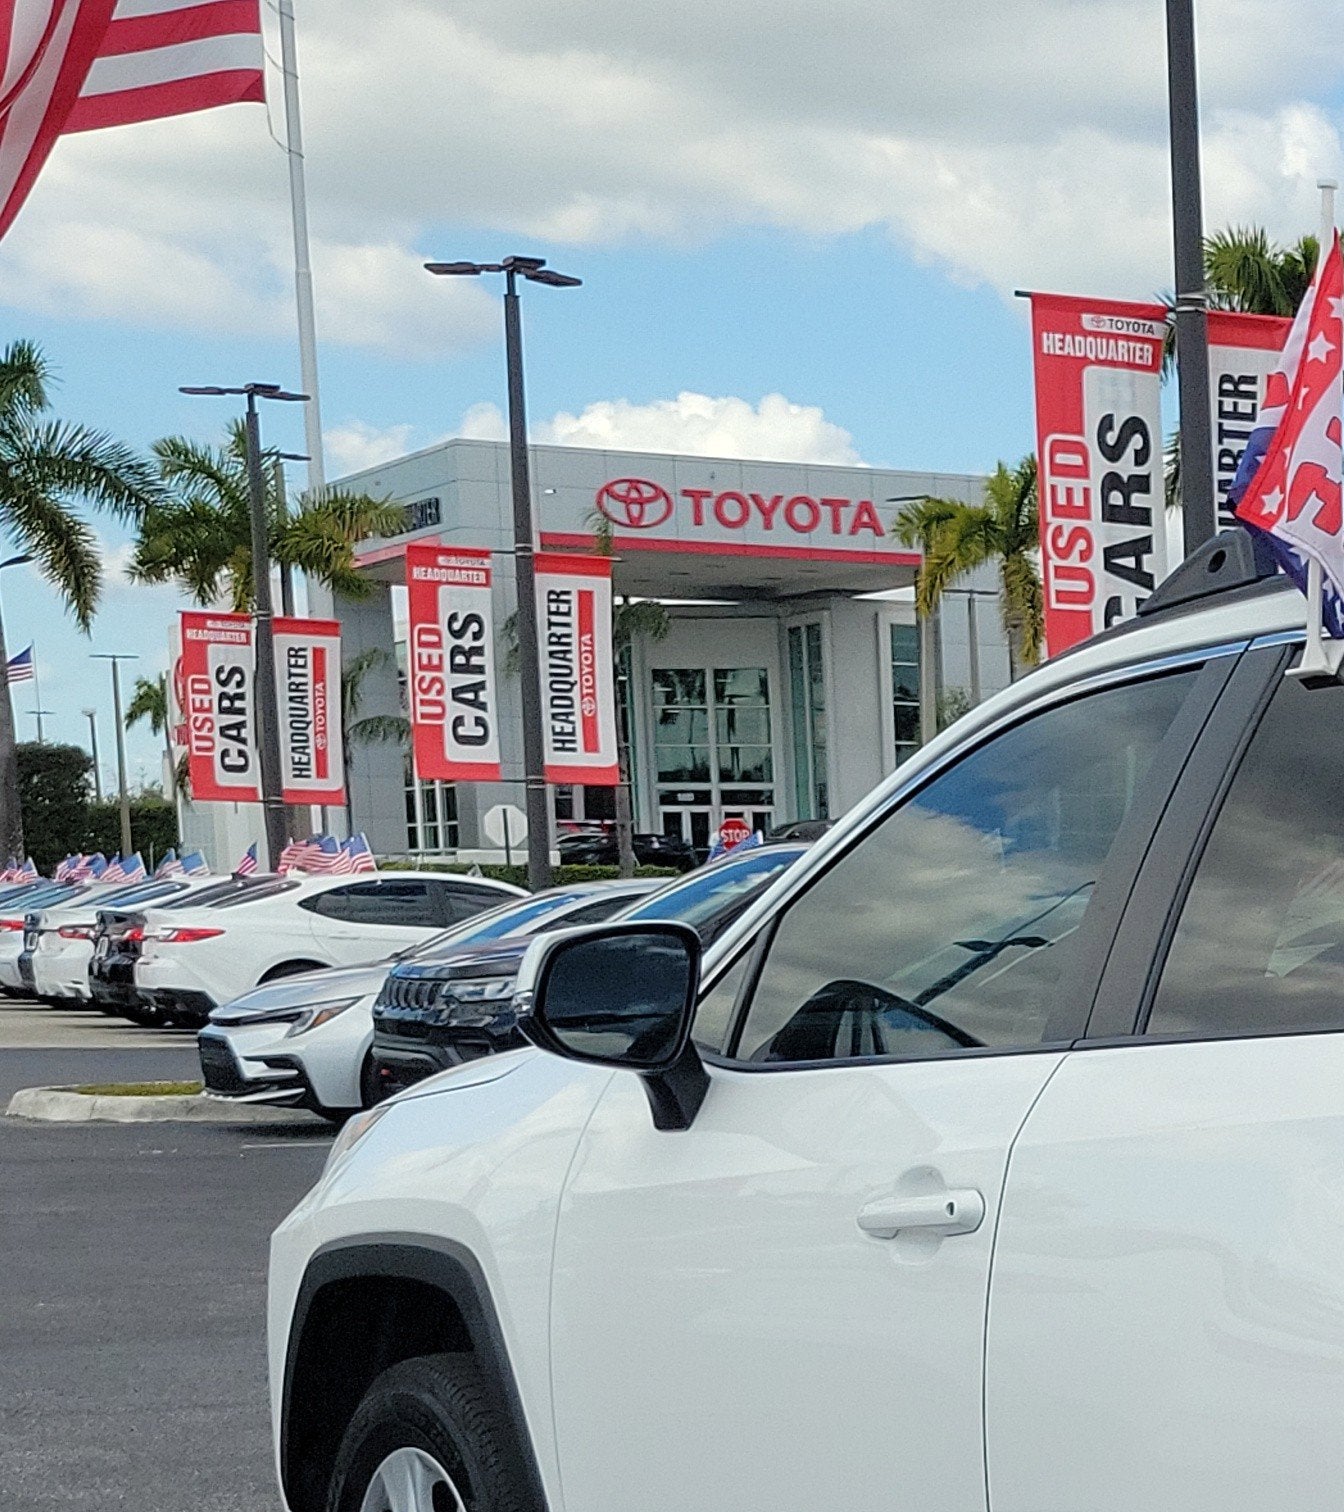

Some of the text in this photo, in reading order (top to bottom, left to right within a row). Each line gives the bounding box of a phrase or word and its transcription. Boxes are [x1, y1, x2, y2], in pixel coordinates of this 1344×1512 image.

[1042, 332, 1153, 366] HEADQUARTER
[1107, 317, 1156, 336] TOYOTA
[681, 488, 886, 537] TOYOTA
[1049, 437, 1096, 608] USED
[416, 625, 446, 724] USED
[447, 612, 491, 747] CARS
[547, 589, 578, 753] HEADQUARTER
[580, 633, 596, 695] TOYOTA
[190, 676, 216, 755] USED
[215, 664, 250, 774] CARS
[287, 646, 312, 779] HEADQUARTER
[315, 682, 327, 736] TOYOTA
[720, 829, 751, 844] STOP
